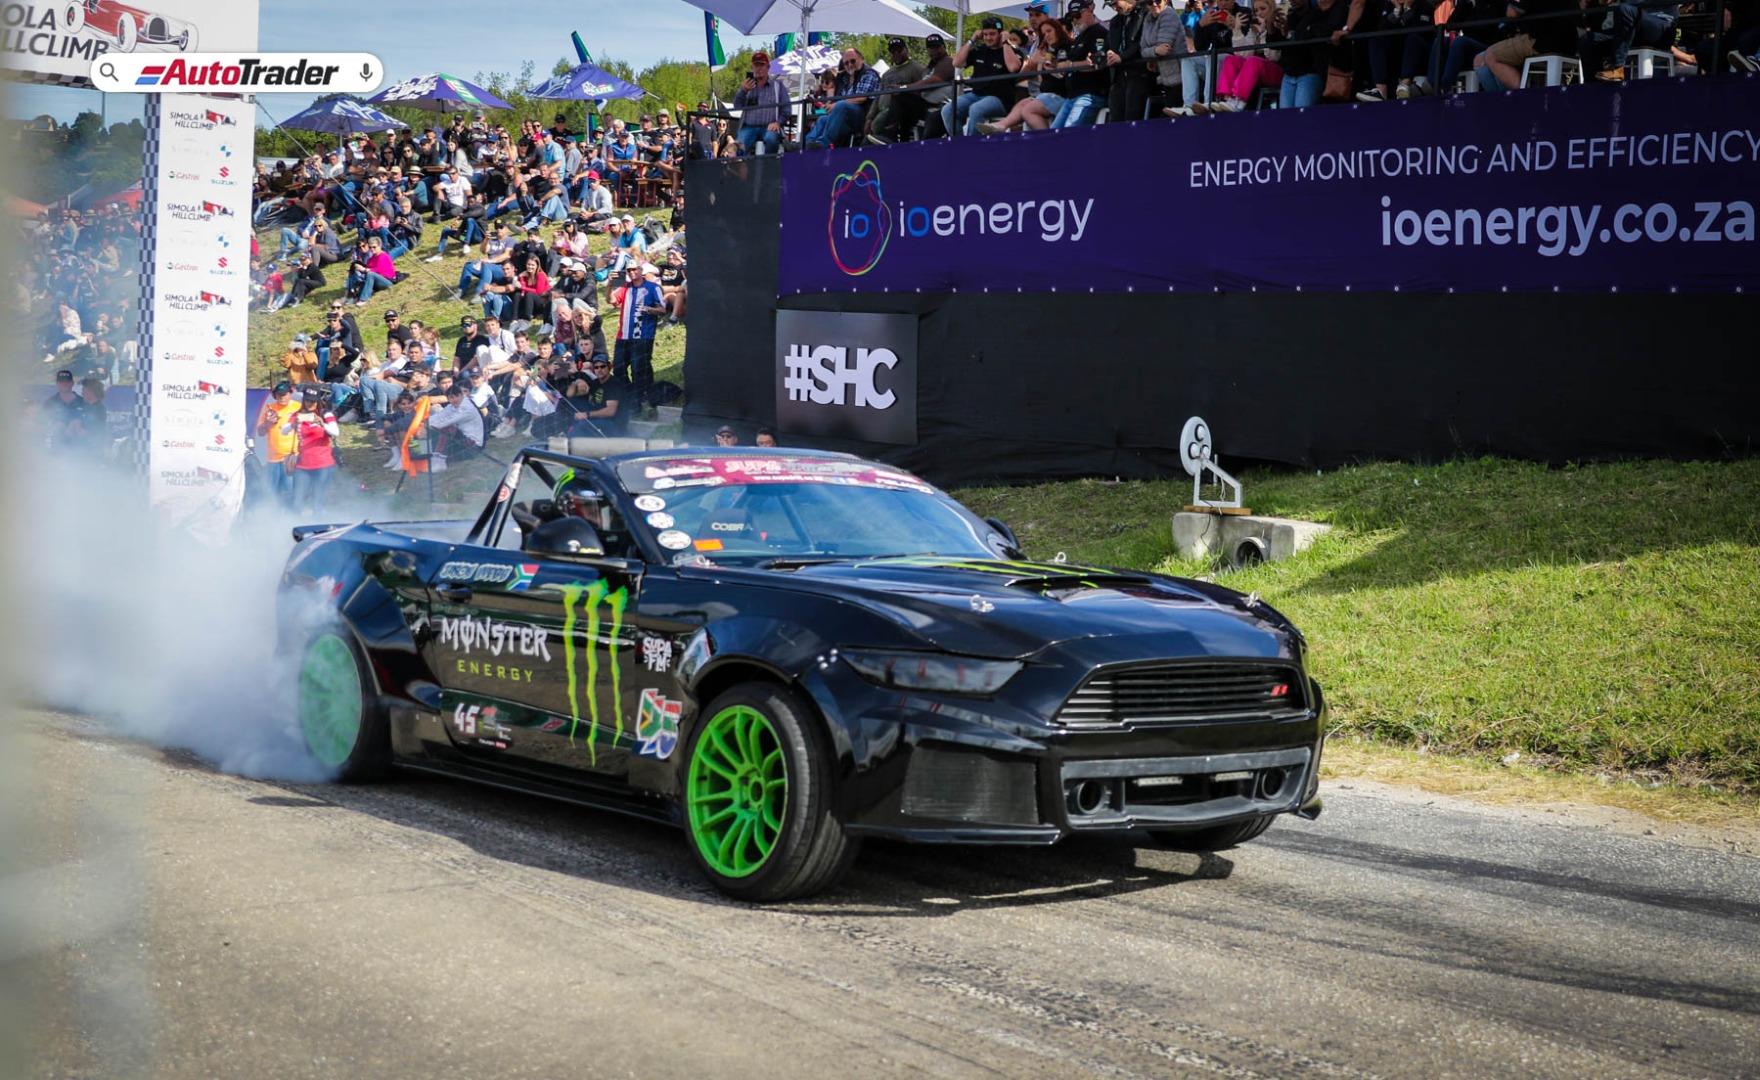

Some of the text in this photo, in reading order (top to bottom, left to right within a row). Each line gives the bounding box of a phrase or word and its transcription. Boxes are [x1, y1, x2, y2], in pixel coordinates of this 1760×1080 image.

[170, 111, 199, 121] SIMOLA
[1190, 129, 1760, 188] ENERGY MONITORING AND EFFICIENCY
[167, 203, 196, 213] SIMOLA
[844, 208, 870, 239] io
[899, 198, 1095, 242] ioenergy
[1381, 195, 1756, 257] ioenergy.co.za
[164, 294, 194, 303] SIMOLA
[161, 384, 192, 393] SIMOLA
[784, 343, 898, 410] #SHC
[457, 659, 534, 683] ENERGY
[454, 702, 480, 735] 45
